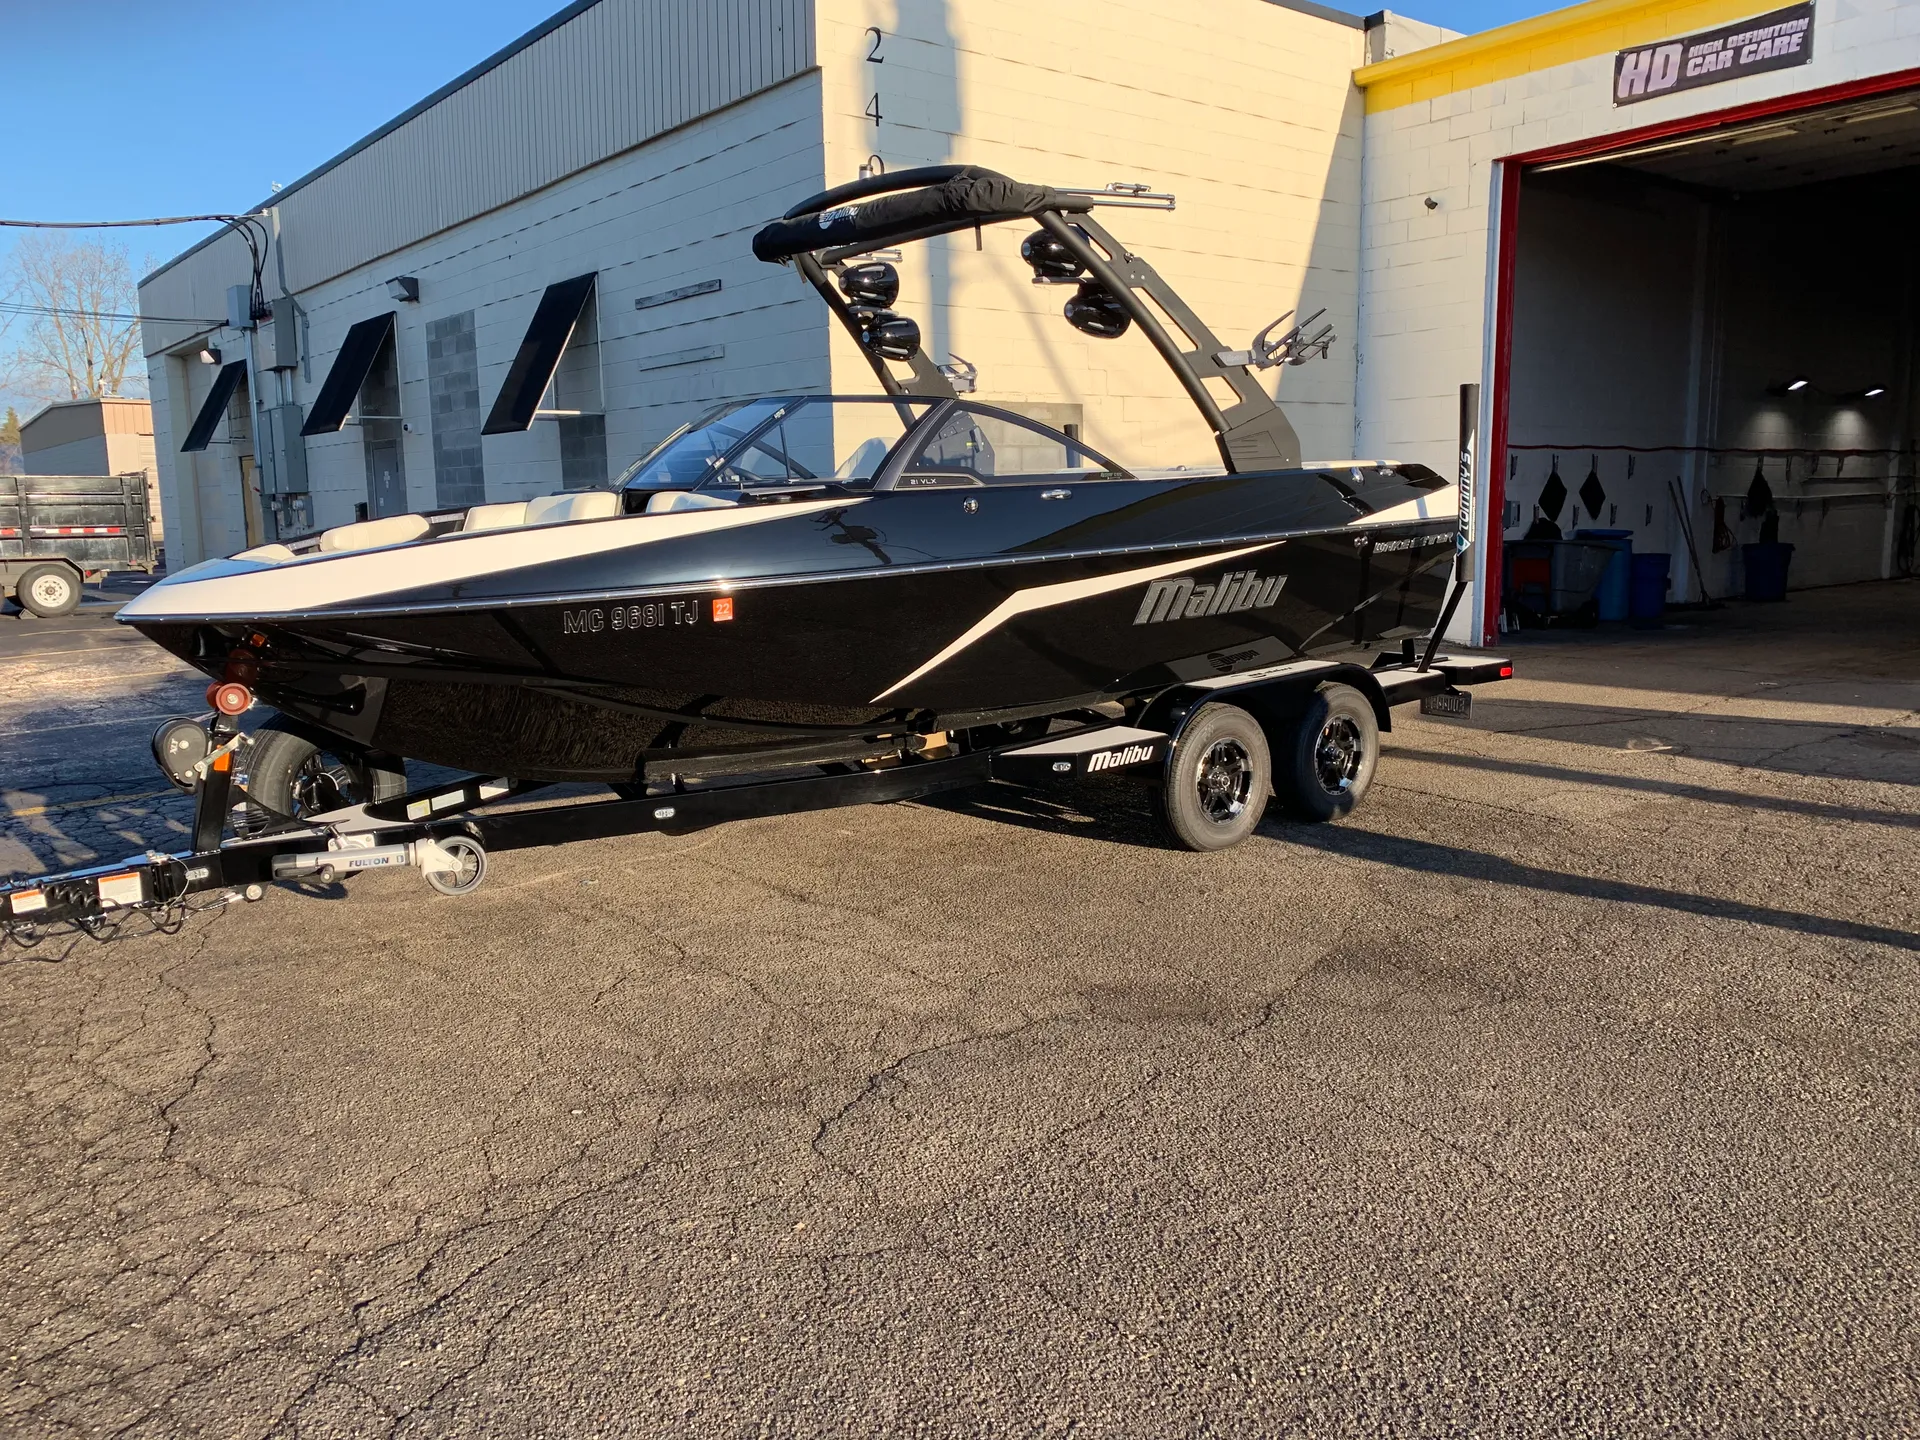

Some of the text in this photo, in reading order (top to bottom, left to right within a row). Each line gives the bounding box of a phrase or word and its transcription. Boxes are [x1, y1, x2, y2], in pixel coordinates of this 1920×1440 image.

[1686, 32, 1804, 77] CAR CARE
[1688, 17, 1810, 58] HIGH DEFINITION
[1617, 42, 1684, 99] HD
[1458, 451, 1472, 532] TOMMY'S
[564, 600, 699, 634] MC 9681 TJ
[716, 603, 730, 615] 22
[1132, 569, 1289, 626] Malibu
[1087, 745, 1154, 773] Malibu
[349, 857, 389, 868] FULTON
